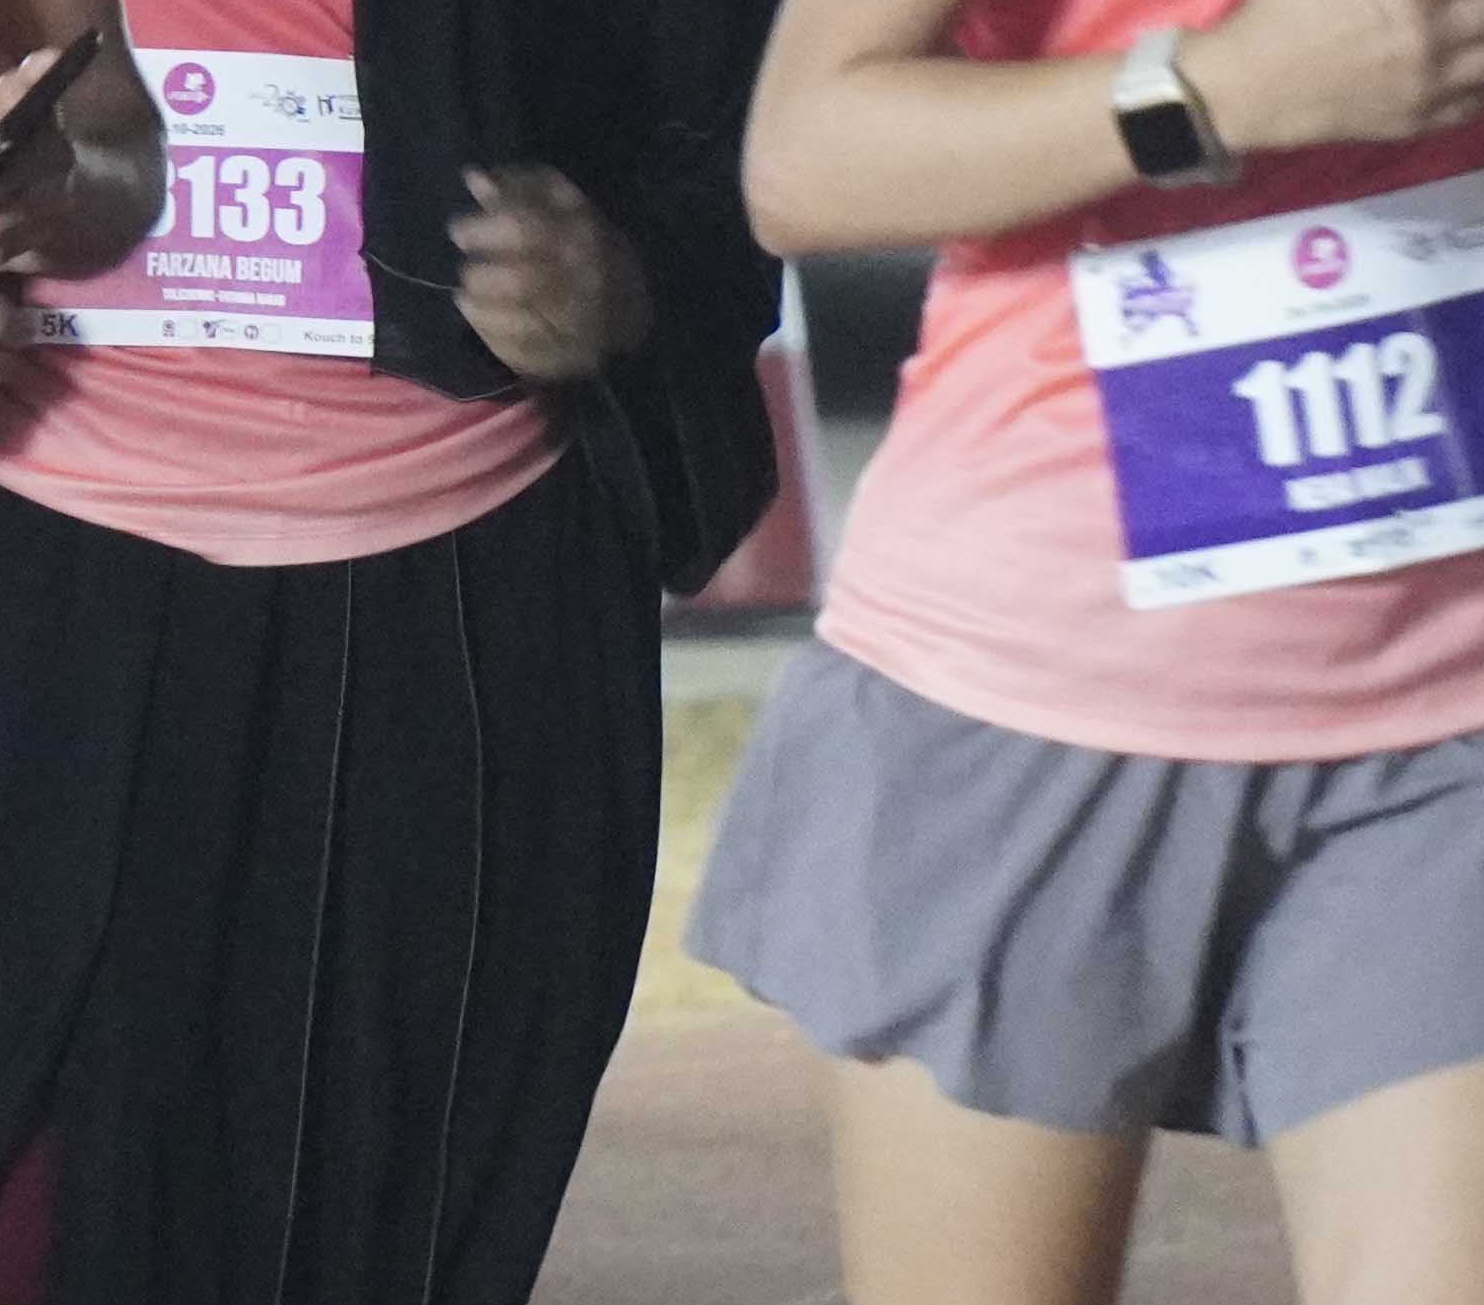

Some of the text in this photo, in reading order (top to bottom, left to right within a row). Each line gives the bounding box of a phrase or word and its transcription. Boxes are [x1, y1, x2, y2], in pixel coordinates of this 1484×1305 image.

[147, 251, 302, 284] FARZANA BEGUM
[41, 313, 80, 337] 5K
[1232, 331, 1446, 468] 1112
